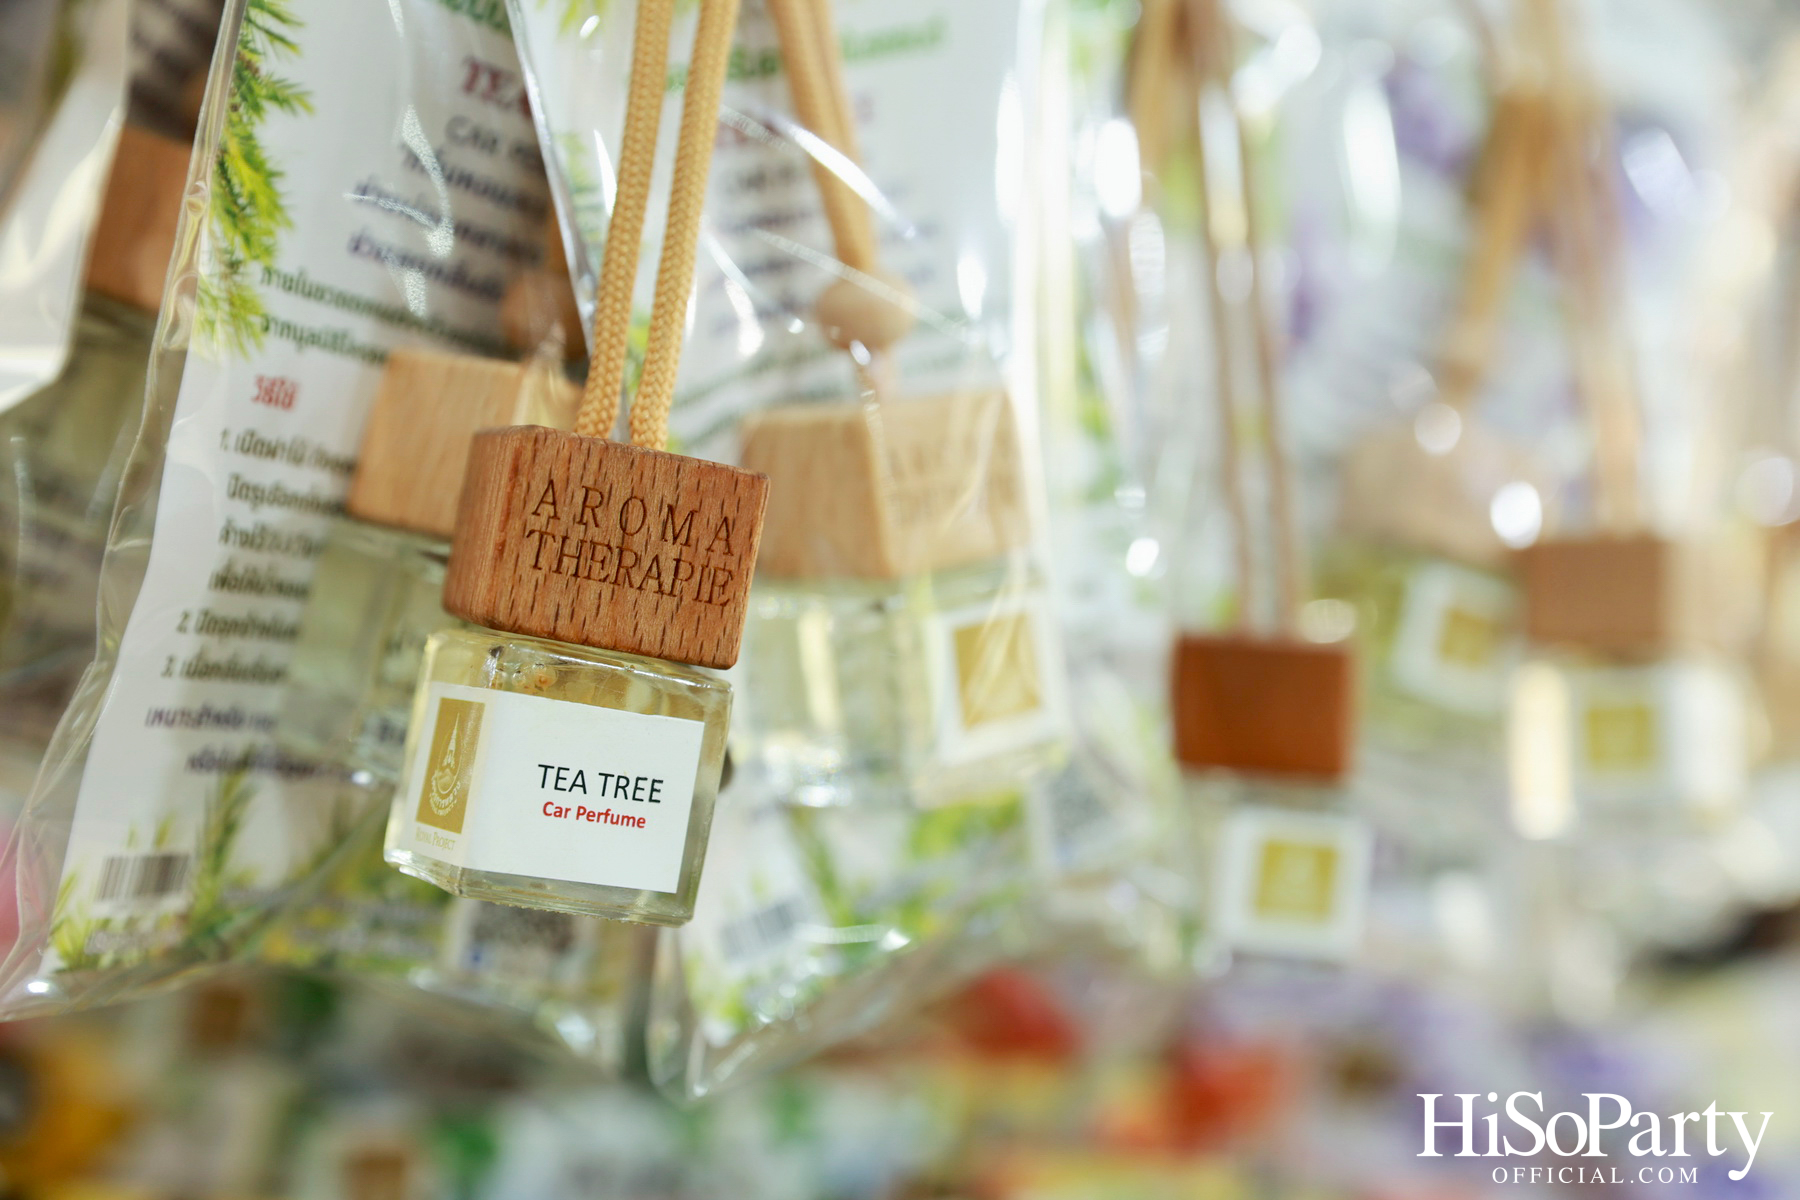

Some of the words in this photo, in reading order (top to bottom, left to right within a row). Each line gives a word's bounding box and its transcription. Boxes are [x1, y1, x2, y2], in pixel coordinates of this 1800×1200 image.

[532, 479, 734, 556] AROMA
[526, 529, 734, 607] THERAPIE
[538, 764, 588, 794] TEA
[598, 772, 664, 803] TREE
[542, 801, 572, 819] Car
[575, 805, 646, 828] Perfume
